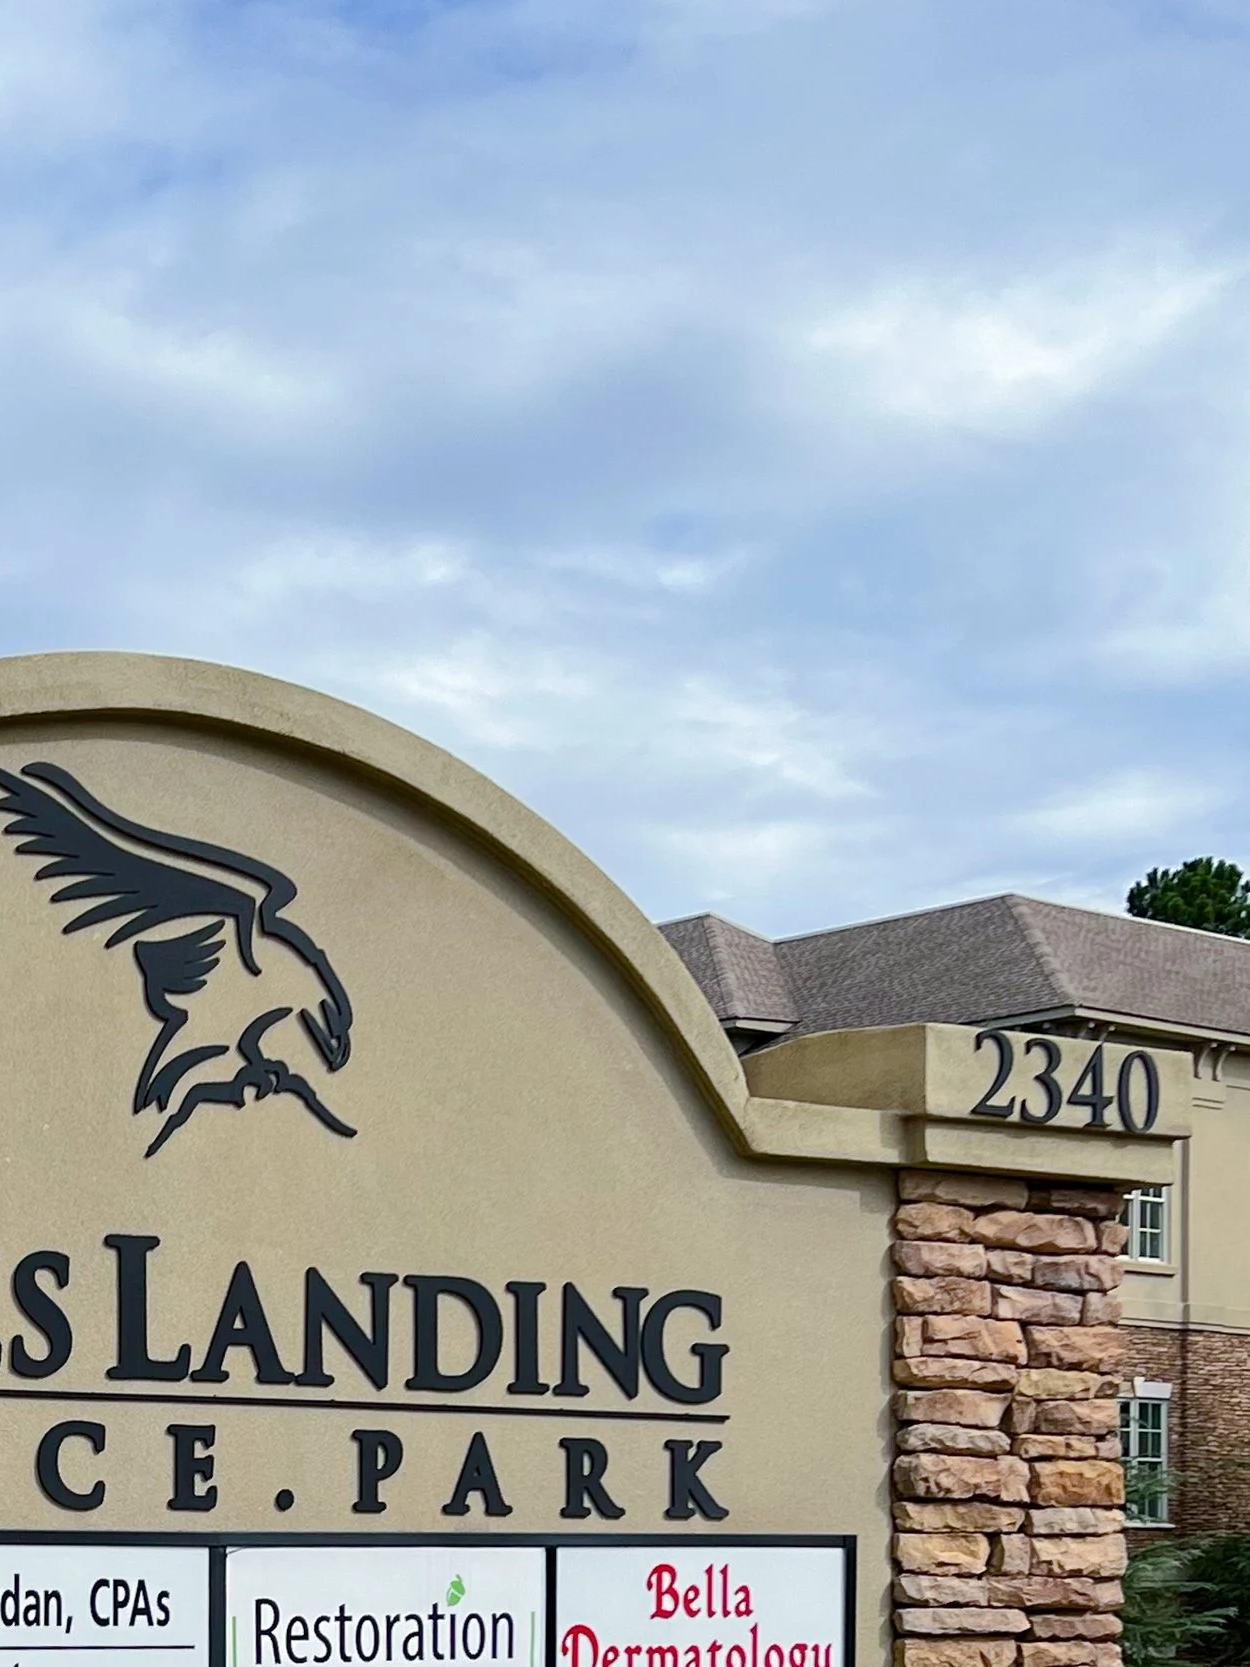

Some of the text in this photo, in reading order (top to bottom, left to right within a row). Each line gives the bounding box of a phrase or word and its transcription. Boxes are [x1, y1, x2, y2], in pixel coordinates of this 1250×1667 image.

[969, 1028, 1160, 1135] 2340
[102, 1234, 730, 1404] LANDING
[350, 1429, 729, 1521] PARK
[90, 1579, 170, 1627] CPAs
[255, 1596, 513, 1664] Restoration
[647, 1564, 753, 1619] Bella
